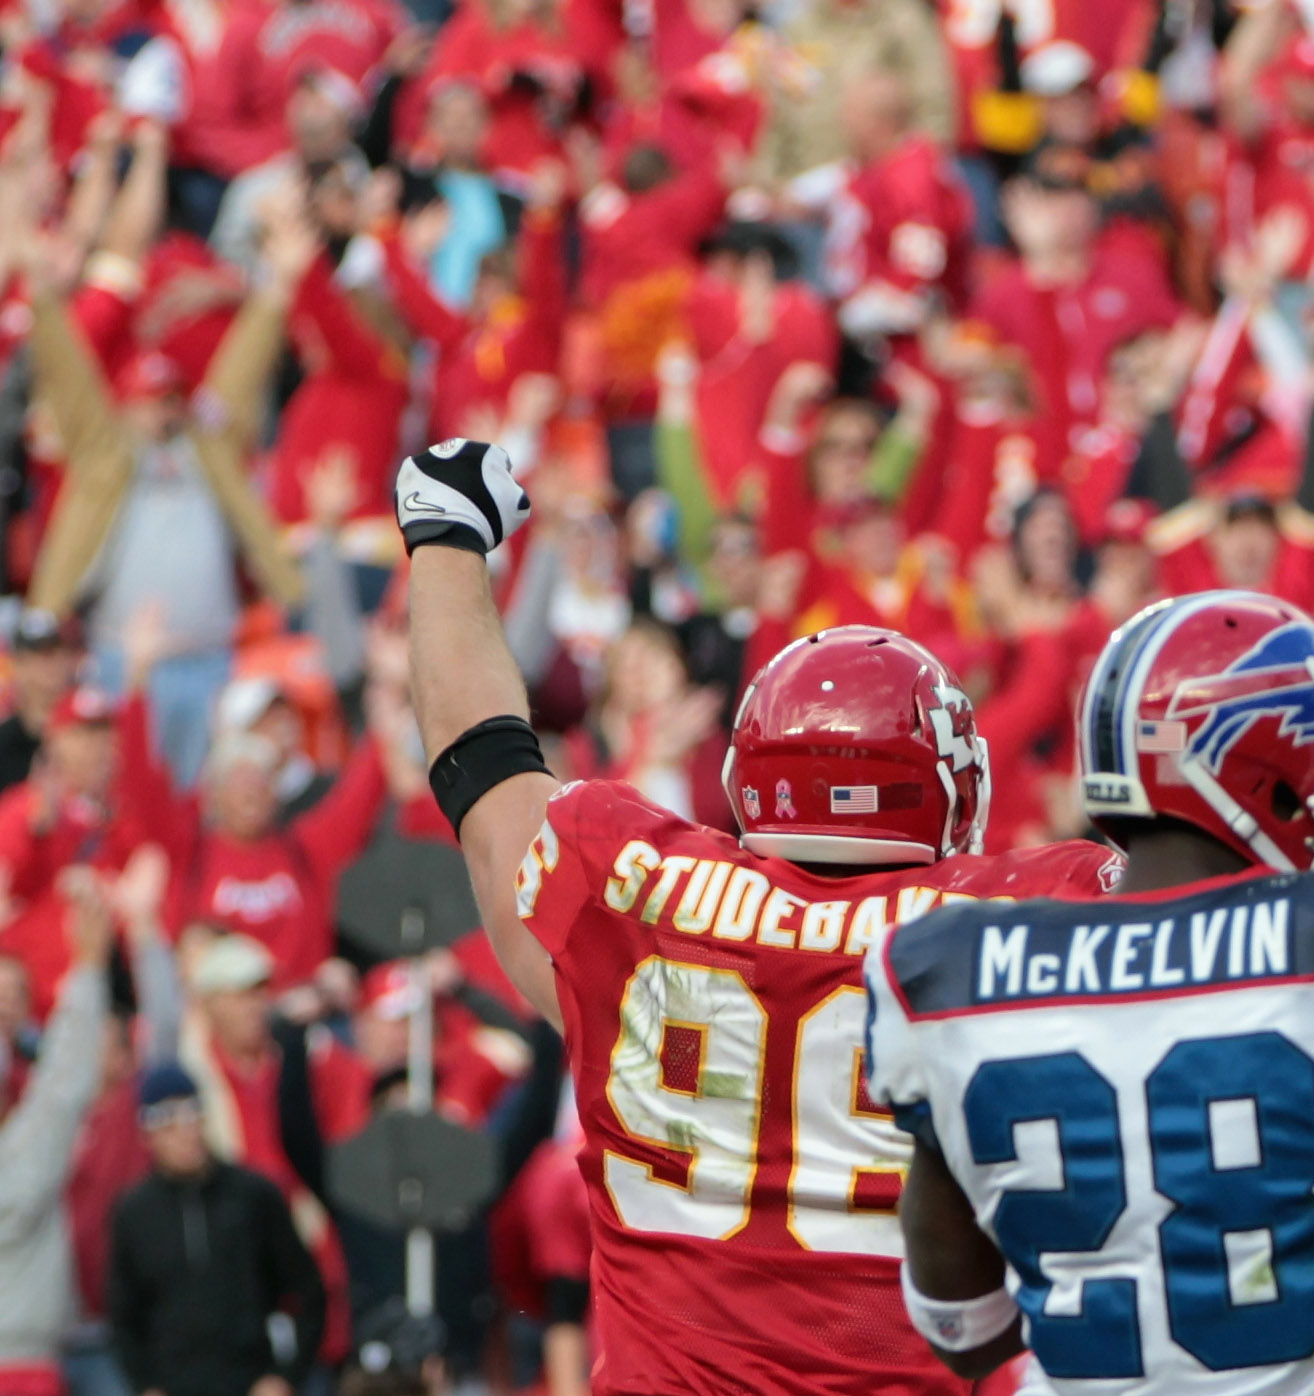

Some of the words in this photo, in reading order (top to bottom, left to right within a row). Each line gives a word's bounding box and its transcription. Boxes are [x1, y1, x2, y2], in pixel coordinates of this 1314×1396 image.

[603, 839, 1017, 956] STUDEBAK
[978, 898, 1290, 999] McKELVIN
[604, 953, 908, 1260] 96
